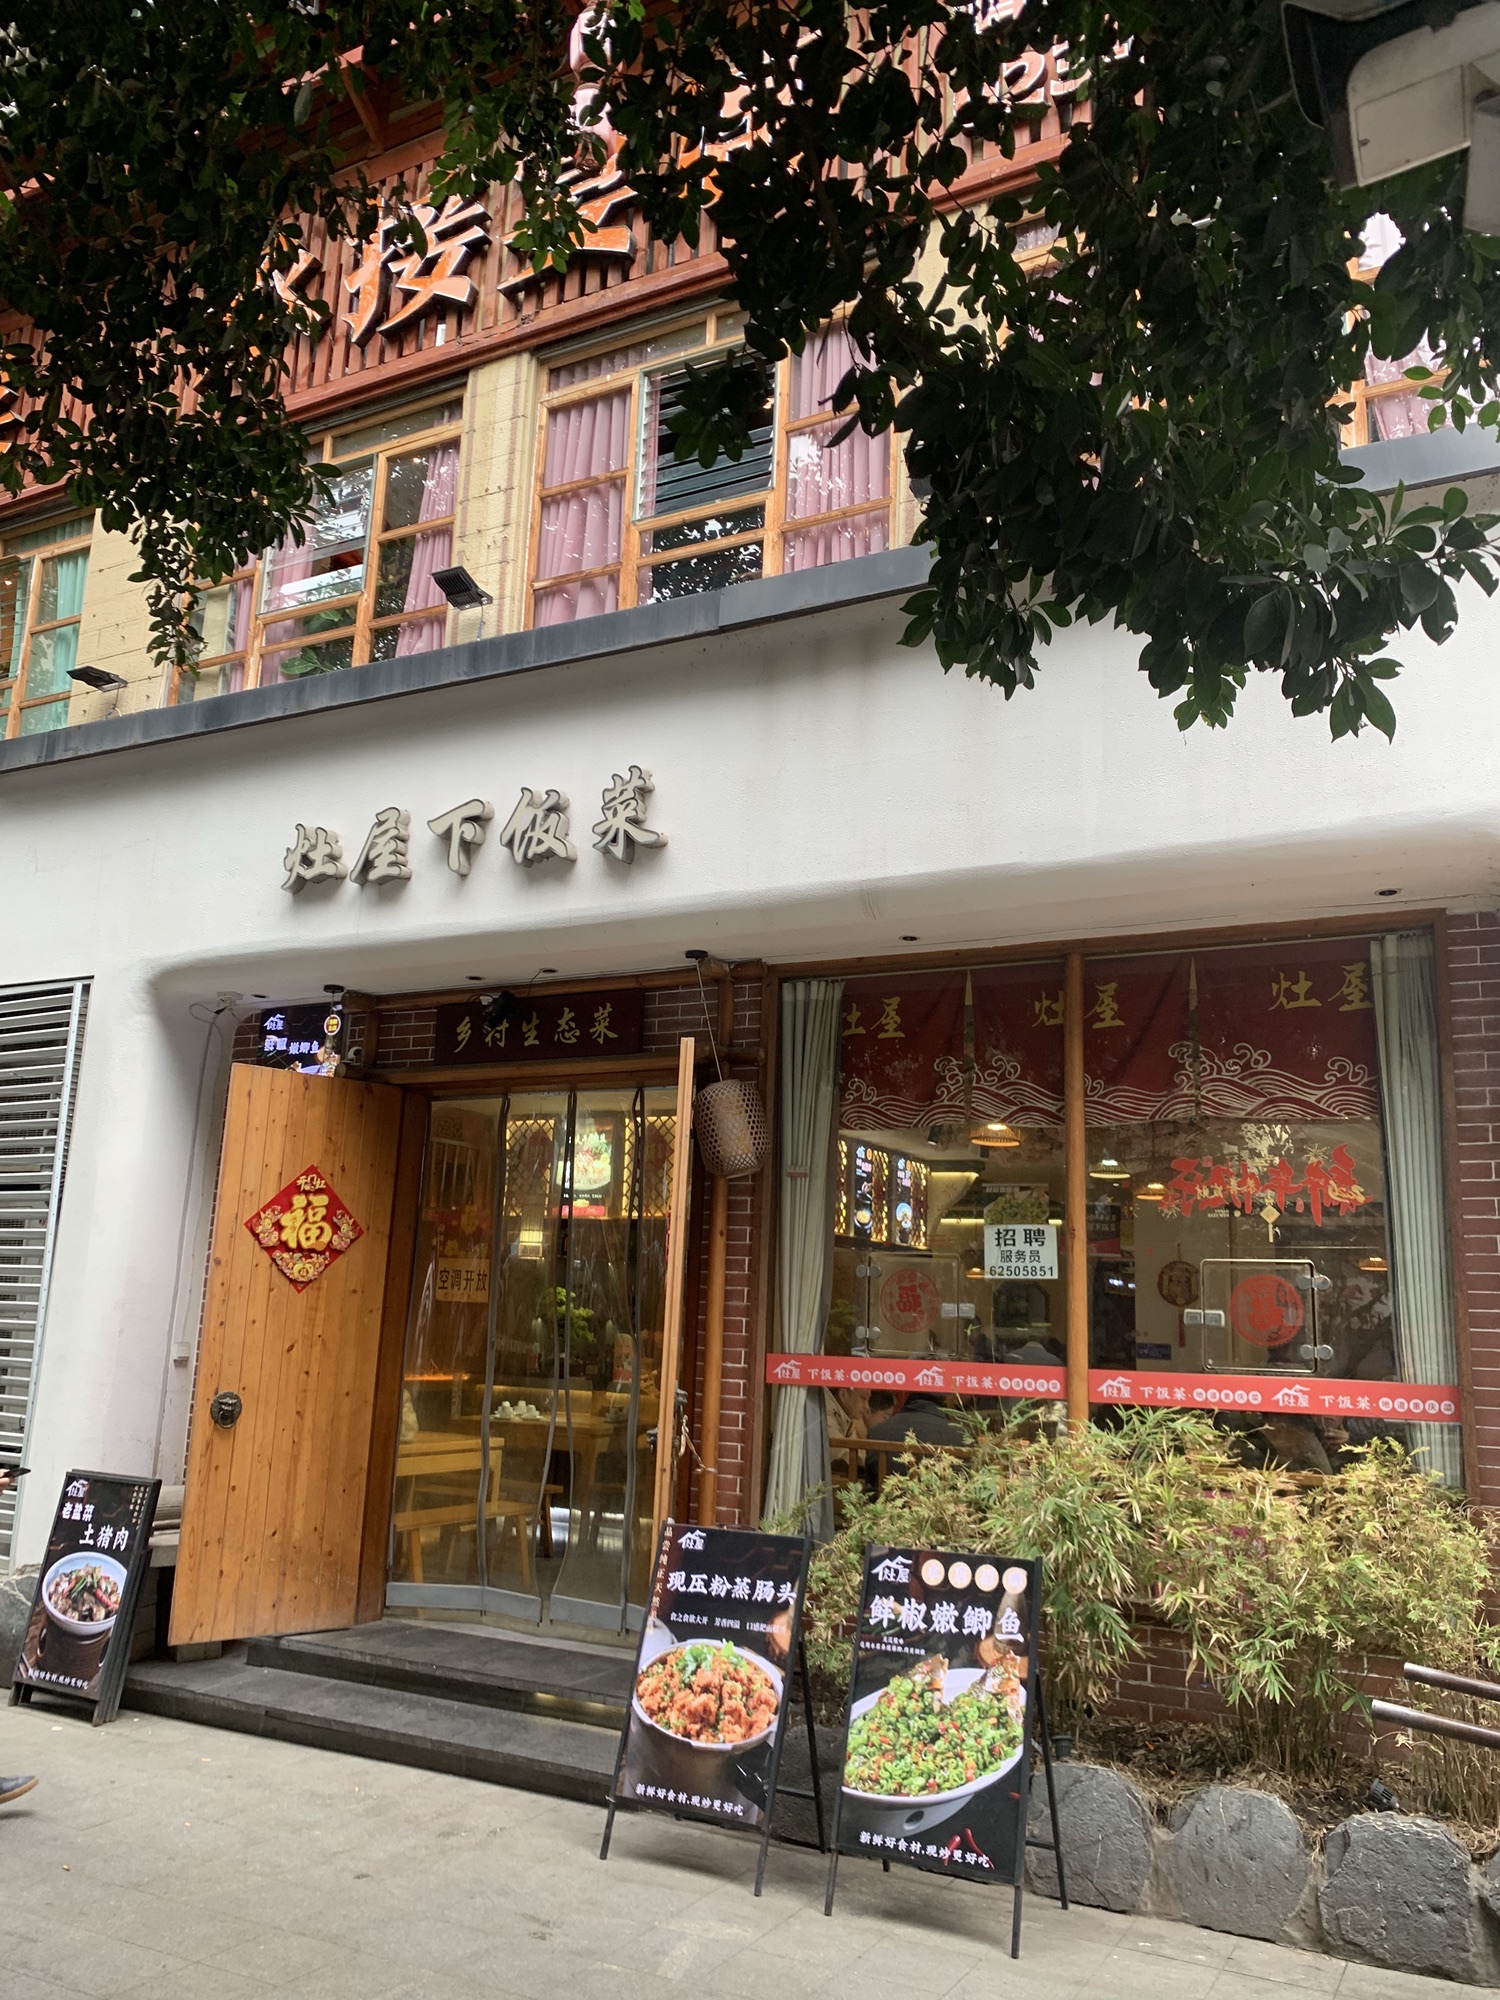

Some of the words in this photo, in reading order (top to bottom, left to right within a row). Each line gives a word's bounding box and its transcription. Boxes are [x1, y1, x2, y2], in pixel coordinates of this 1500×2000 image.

[281, 765, 669, 894] 灶屋下饭菜
[1268, 962, 1374, 1011] 灶屋
[296, 1174, 326, 1191] 开门红
[279, 1193, 332, 1252] 福
[995, 1228, 1046, 1247] 招聘
[989, 1265, 1054, 1277] 62505851
[1000, 1250, 1041, 1263] 服务员
[438, 1268, 488, 1292] 空调开放
[79, 1523, 129, 1552] 土猪肉
[667, 1570, 798, 1605] 现压粉蒸肠头
[869, 1594, 1024, 1643] 鲜椒嫩鲫鱼
